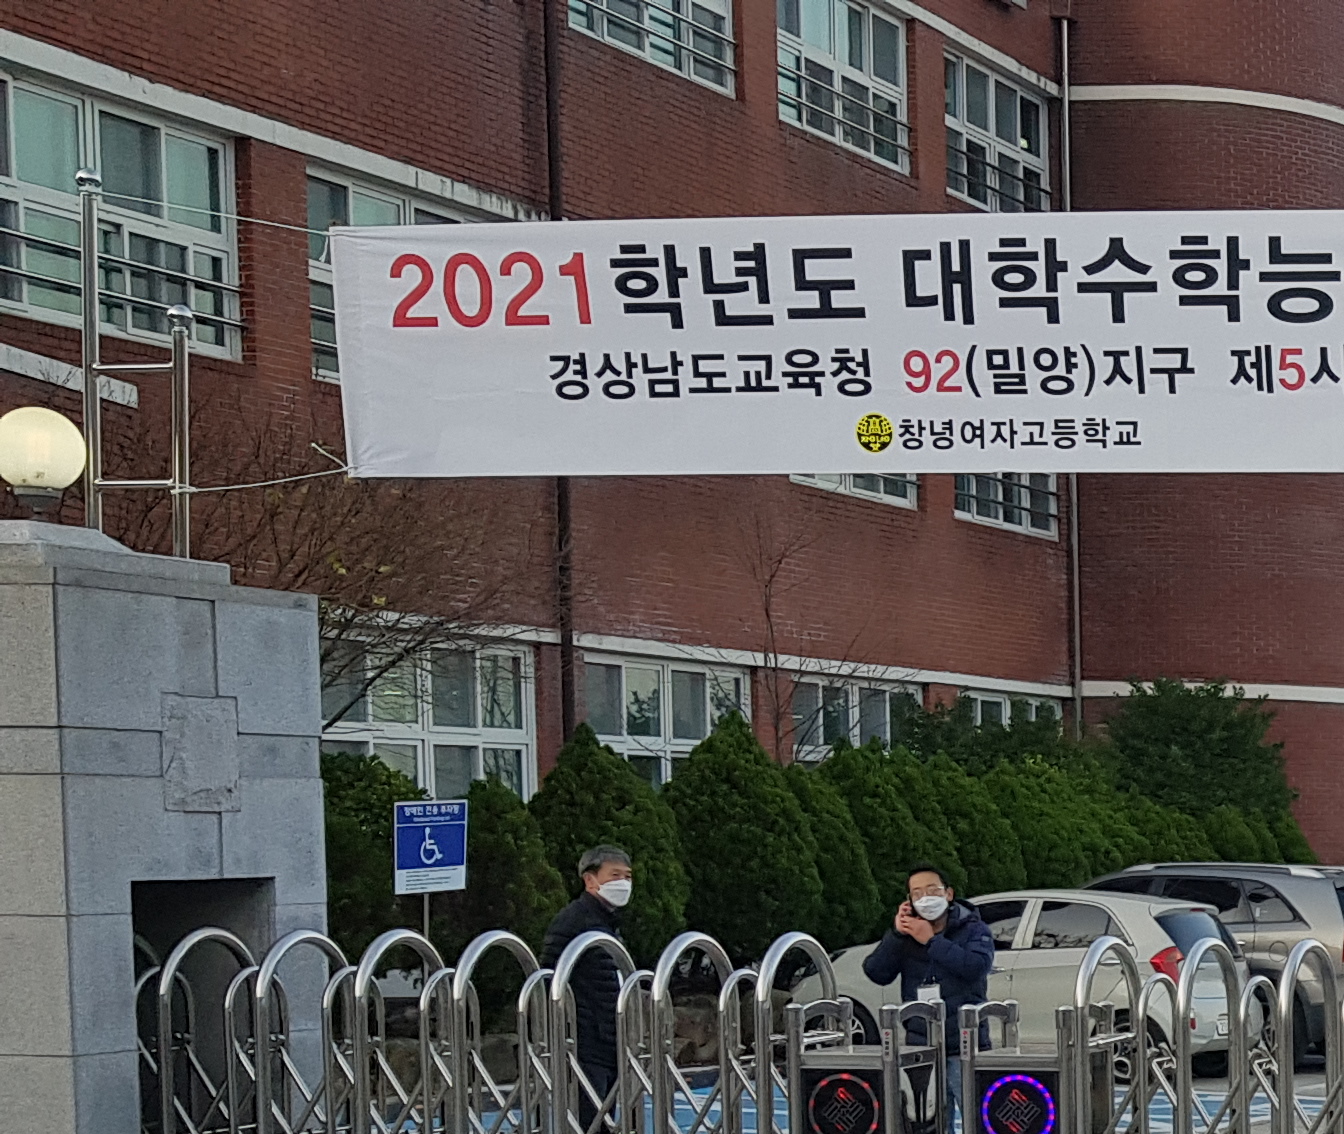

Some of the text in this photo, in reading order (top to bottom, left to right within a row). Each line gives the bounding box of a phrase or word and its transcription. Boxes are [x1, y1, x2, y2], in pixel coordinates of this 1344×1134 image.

[388, 242, 867, 329] 2021학년도
[549, 347, 874, 400] 경상남도교육청
[903, 343, 1197, 397] 92(밀양)지구
[898, 417, 1143, 451] 창녕여자고등학교
